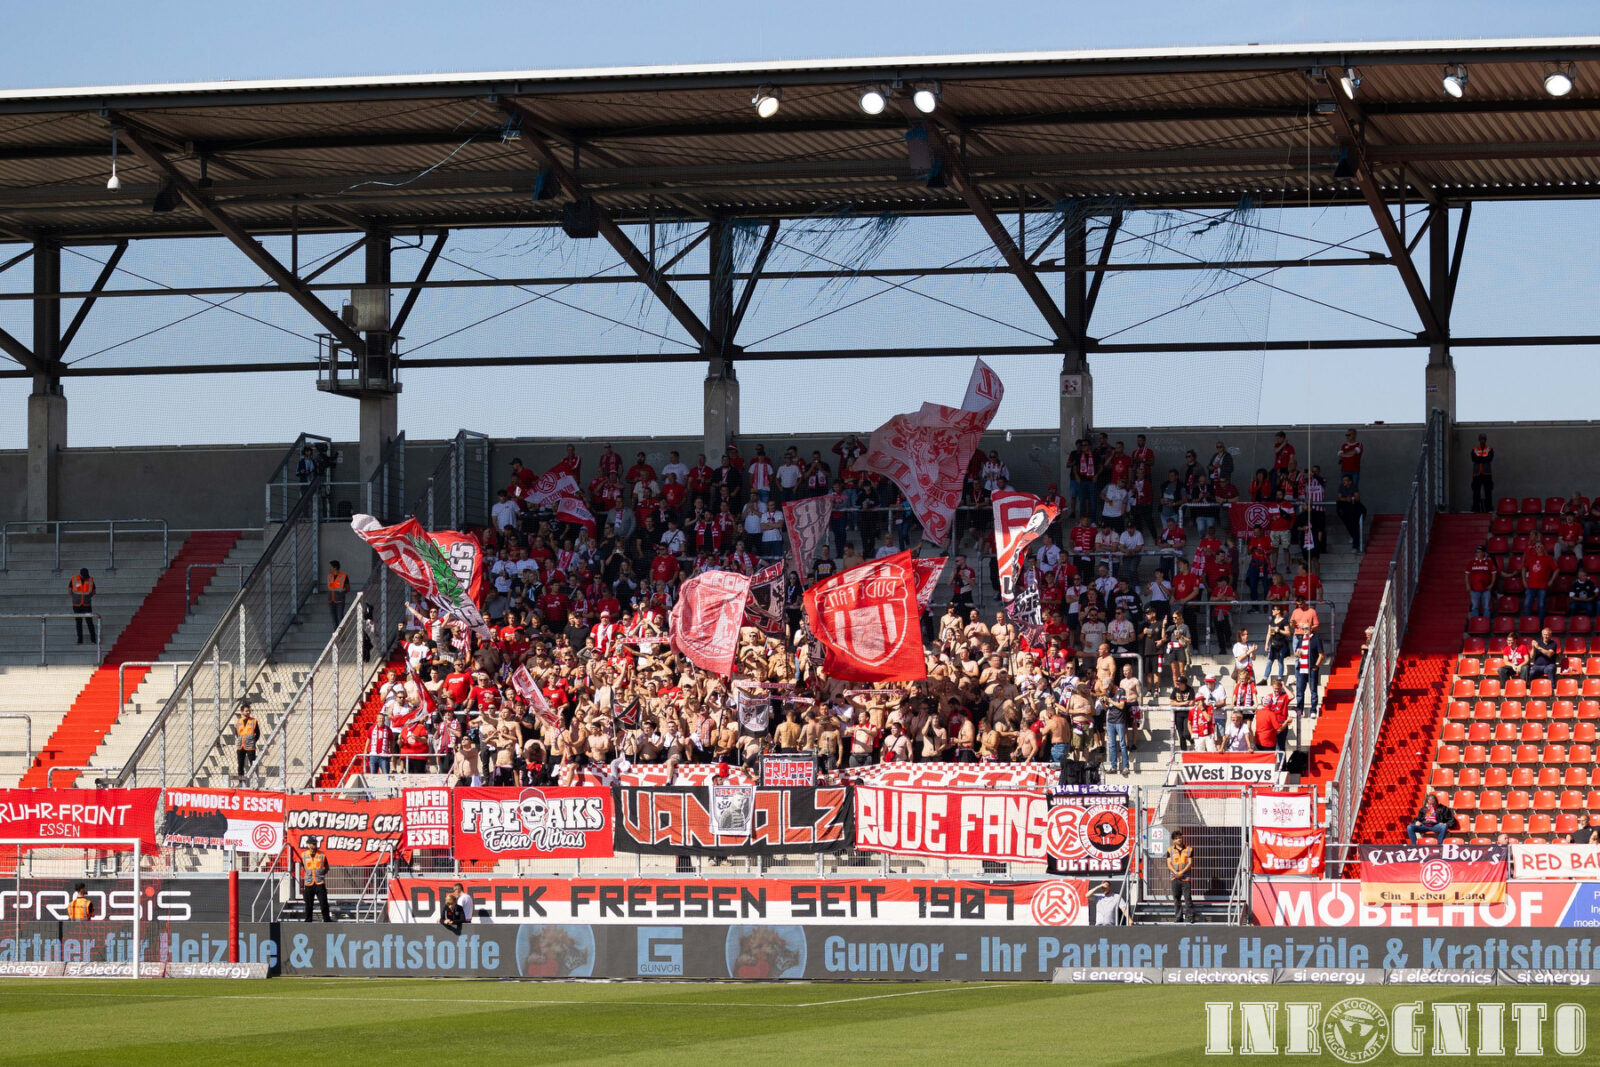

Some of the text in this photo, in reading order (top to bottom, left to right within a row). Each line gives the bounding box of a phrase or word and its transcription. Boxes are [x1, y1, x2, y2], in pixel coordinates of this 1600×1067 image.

[1184, 765, 1272, 783] West Boys
[167, 792, 284, 813] TOPMODELS ESSEN
[405, 790, 449, 807] HAFEN
[1050, 796, 1126, 806] JUNGE ESSENER
[287, 810, 403, 834] NORTHSIDE CRE
[405, 808, 449, 825] SÄNGER
[856, 787, 1049, 857] RUDE FANS
[40, 823, 80, 837] ESSEN
[407, 828, 449, 847] ESSEN
[483, 825, 585, 852] Essen Ultras
[299, 835, 324, 850] RT
[326, 835, 364, 852] WEISS
[1057, 859, 1122, 872] ULTRAS
[1522, 851, 1600, 871] RED BA
[570, 885, 767, 918] FRESSEN
[791, 885, 886, 918] SEIT
[913, 886, 1014, 920] 1907
[1274, 883, 1543, 926] MÖBELHOF
[1379, 891, 1487, 902] Ein Leben Lang
[290, 934, 314, 969] &
[326, 933, 500, 969] Kraftstoffe
[824, 935, 944, 972] Gunvor
[981, 936, 1027, 973] Ihr
[1038, 936, 1168, 973] Partner
[1178, 936, 1227, 968] für
[1239, 936, 1369, 969] Heizöle
[1383, 938, 1409, 968] &
[184, 963, 250, 978] si energy
[640, 963, 681, 973] GUNVOR
[1072, 969, 1144, 984] si energy
[1168, 970, 1269, 983] si electronics
[1294, 970, 1365, 985] si energy
[1390, 970, 1492, 984] si electronics
[1517, 971, 1590, 986] si energy
